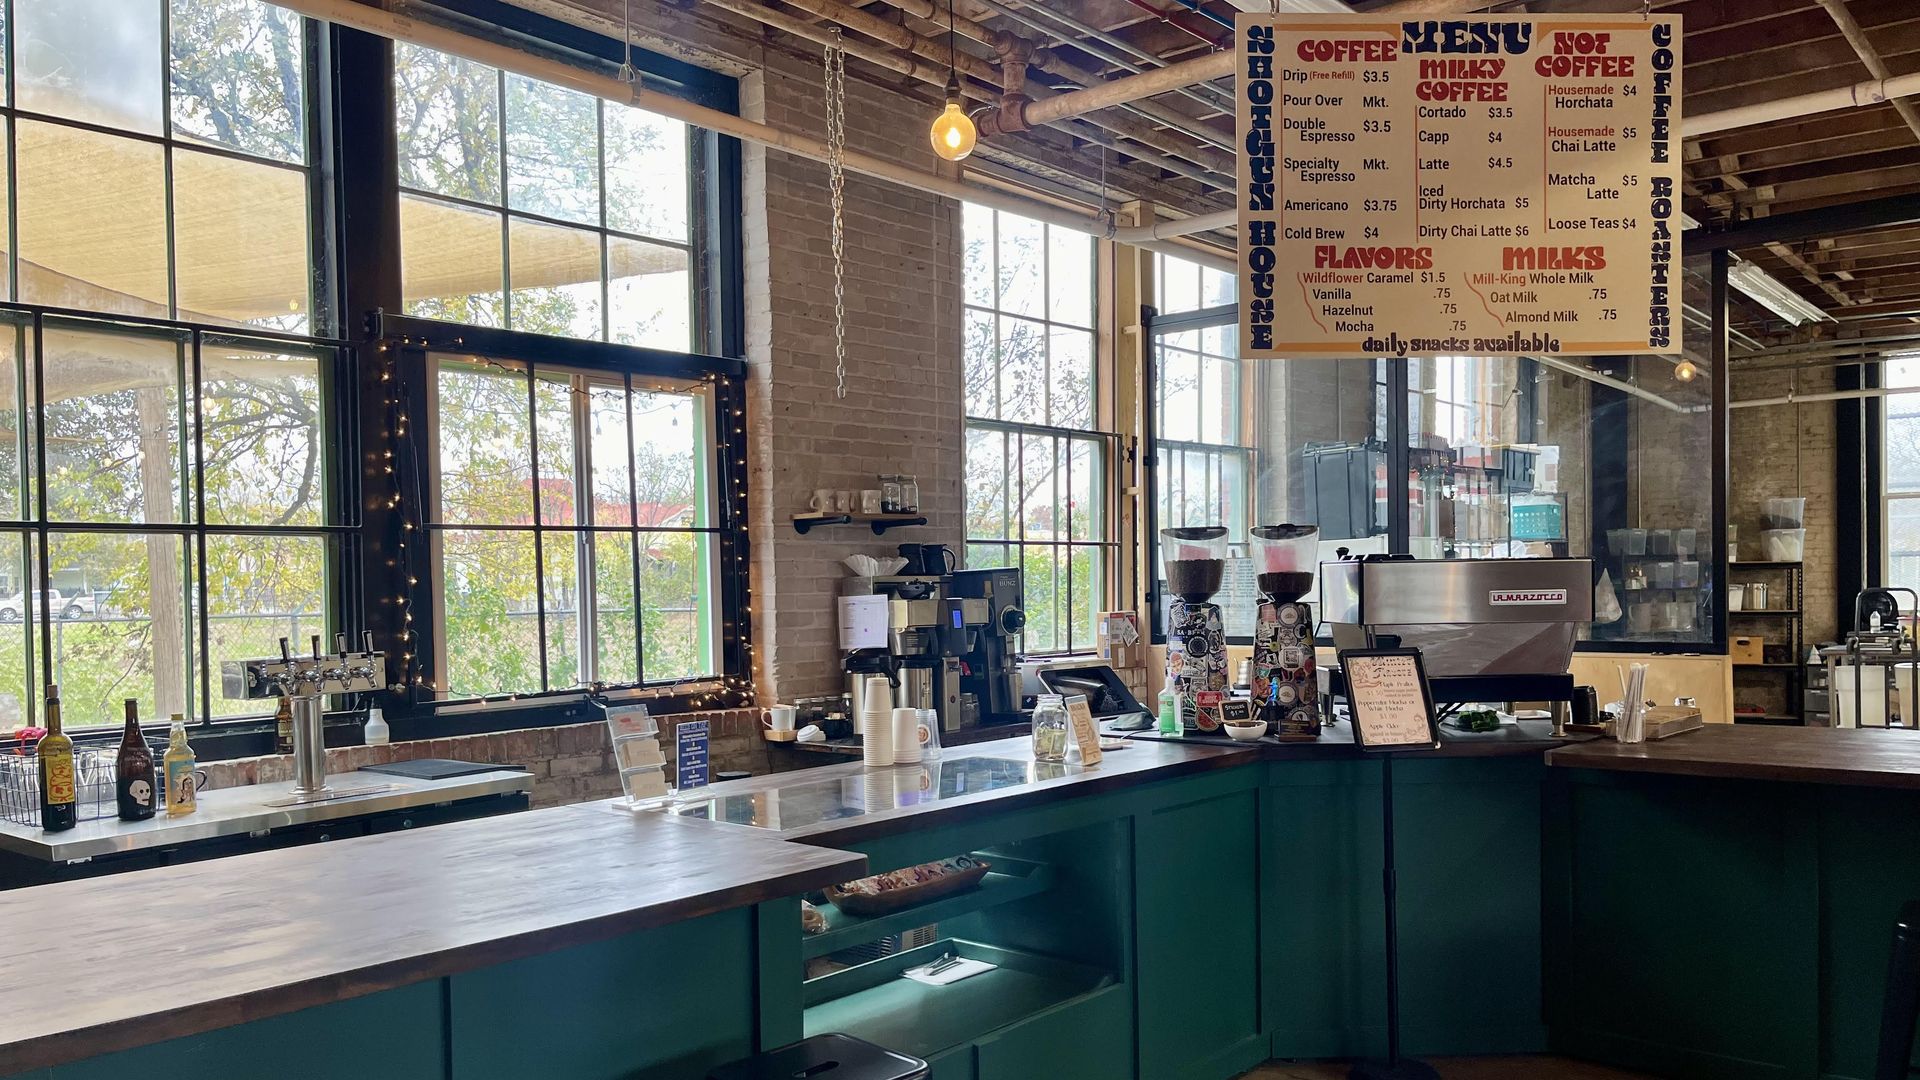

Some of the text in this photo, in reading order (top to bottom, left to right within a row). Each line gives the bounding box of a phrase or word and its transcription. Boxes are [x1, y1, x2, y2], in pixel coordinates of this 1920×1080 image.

[1402, 21, 1531, 54] MENU
[1554, 32, 1610, 55] NOT
[1297, 40, 1397, 62] COFFEE
[1420, 59, 1505, 79] MILKY
[1535, 56, 1634, 77] COFFEE
[1284, 69, 1389, 84] Drip (Free Refill) $3.5
[1416, 81, 1508, 102] COFFEE
[1549, 84, 1636, 96] Housemade $4
[1284, 94, 1388, 107] Pour Over Mkt.
[1556, 96, 1613, 108] Horchata
[1419, 106, 1512, 118] Cortado $3.5
[1284, 118, 1390, 133] Double $3.5
[1548, 125, 1636, 139] Housemade $5
[1301, 130, 1355, 144] Espresso
[1419, 131, 1502, 144] Capp $4
[1552, 139, 1615, 152] Chai Latte
[1284, 157, 1389, 171] Specialty Mkt.
[1419, 157, 1512, 169] Latte $4.5
[1301, 170, 1355, 184] Espresso
[1549, 173, 1637, 186] Matcha $5
[1246, 25, 1276, 349] SHOTGUN HOUSE
[1420, 185, 1443, 196] Iced
[1649, 24, 1674, 347] COFFEE ROASTERS
[1587, 188, 1618, 199] Latte
[1284, 199, 1396, 212] Americano $3.75
[1420, 197, 1528, 212] Dirty Horchata $5
[1549, 217, 1636, 229] Loose Teas $4
[1285, 226, 1378, 239] Cold Brew $4
[1420, 225, 1529, 239] Dirty Chai Latte $6
[1315, 245, 1432, 269] FLAVORS
[1503, 246, 1606, 270] MILKS
[1303, 271, 1445, 283] Wildflower Caramel $1.5
[1474, 272, 1593, 287] Mill-King Whole Milk
[1313, 288, 1450, 299] Vanilla .75
[1491, 289, 1606, 303] Oat Milk .75
[1323, 304, 1456, 315] Hazelnut .75
[1506, 309, 1616, 322] Almond Milk .75
[1336, 321, 1466, 331] Mocha .75
[1362, 331, 1559, 356] daily snacks available
